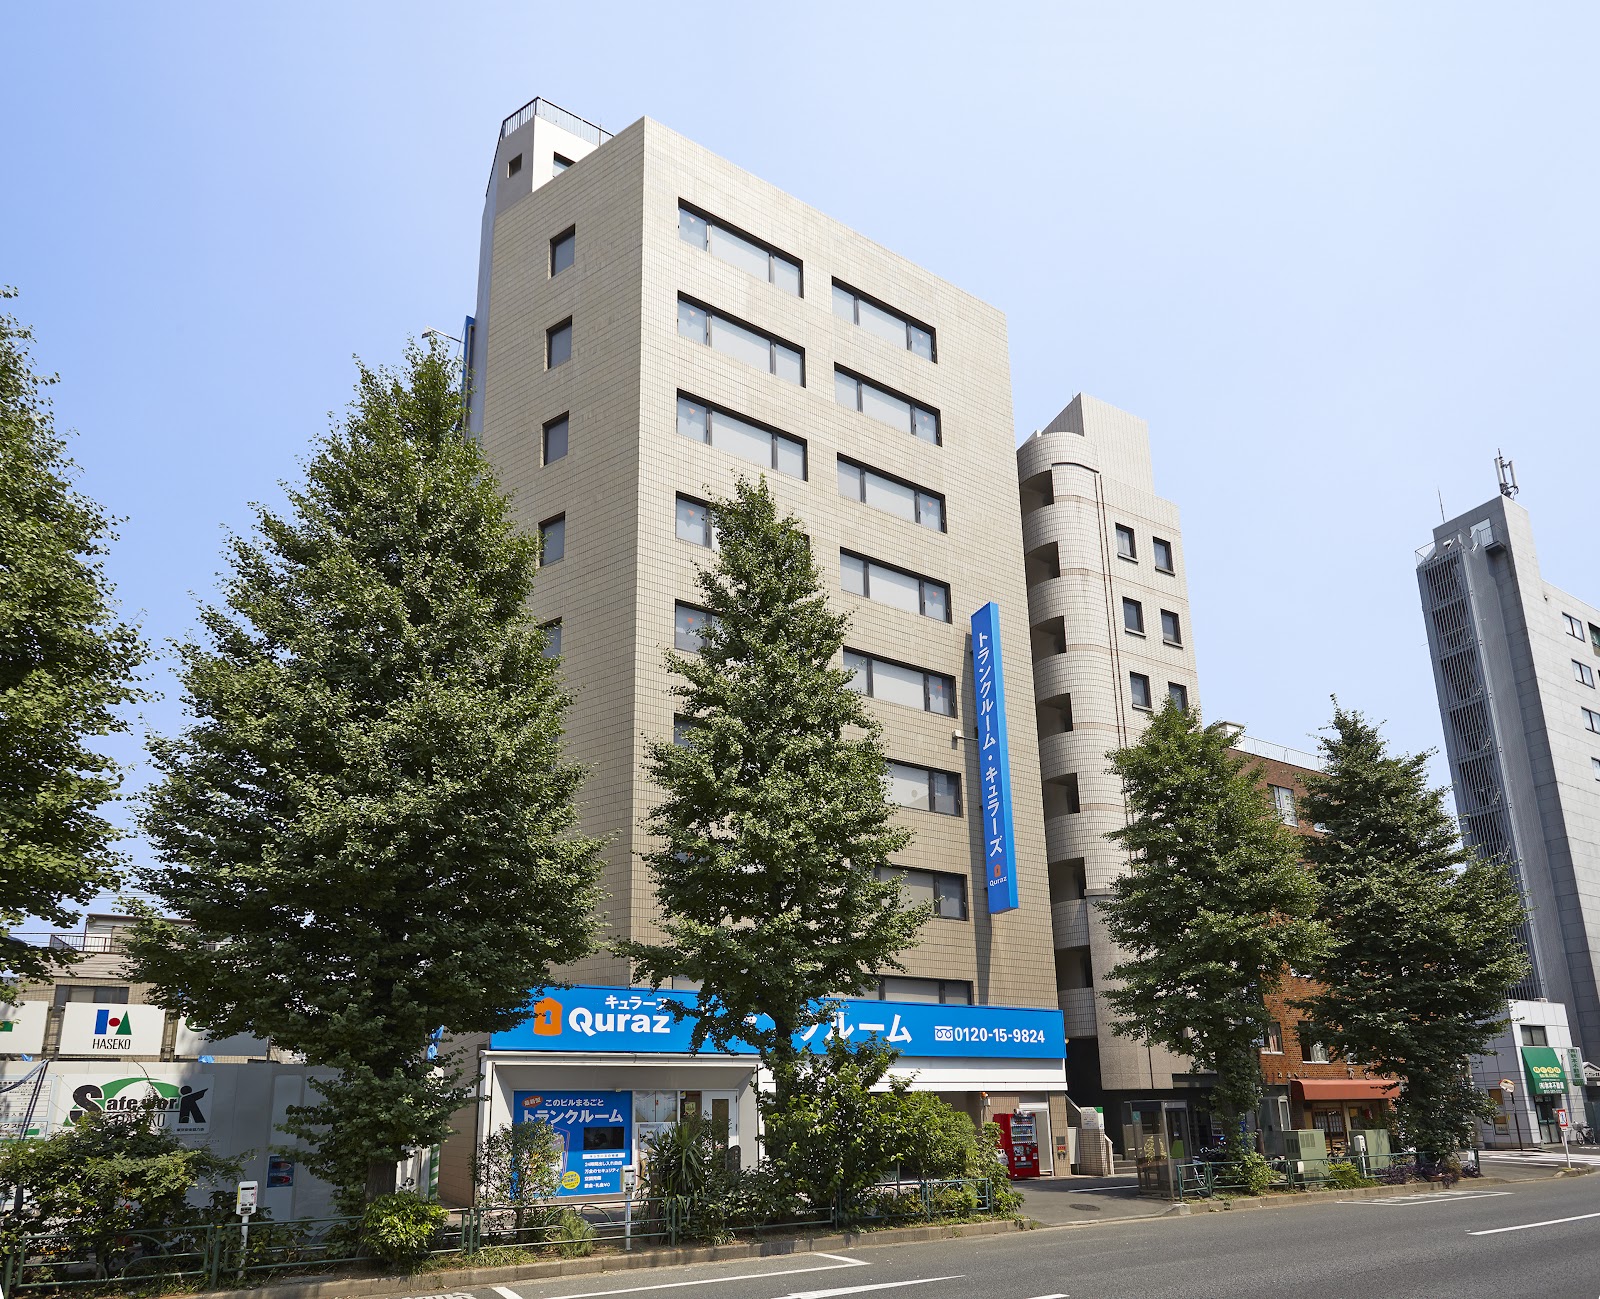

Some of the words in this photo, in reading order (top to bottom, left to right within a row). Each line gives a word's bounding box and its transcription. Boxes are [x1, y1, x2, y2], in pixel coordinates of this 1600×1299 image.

[990, 876, 1007, 886] Quraz
[568, 1007, 671, 1037] Quraz
[954, 1027, 1046, 1043] 0120-15-9824
[92, 1038, 131, 1050] HASEKO
[545, 1099, 604, 1107] このビルまるごと
[524, 1109, 624, 1124] トランクルーム
